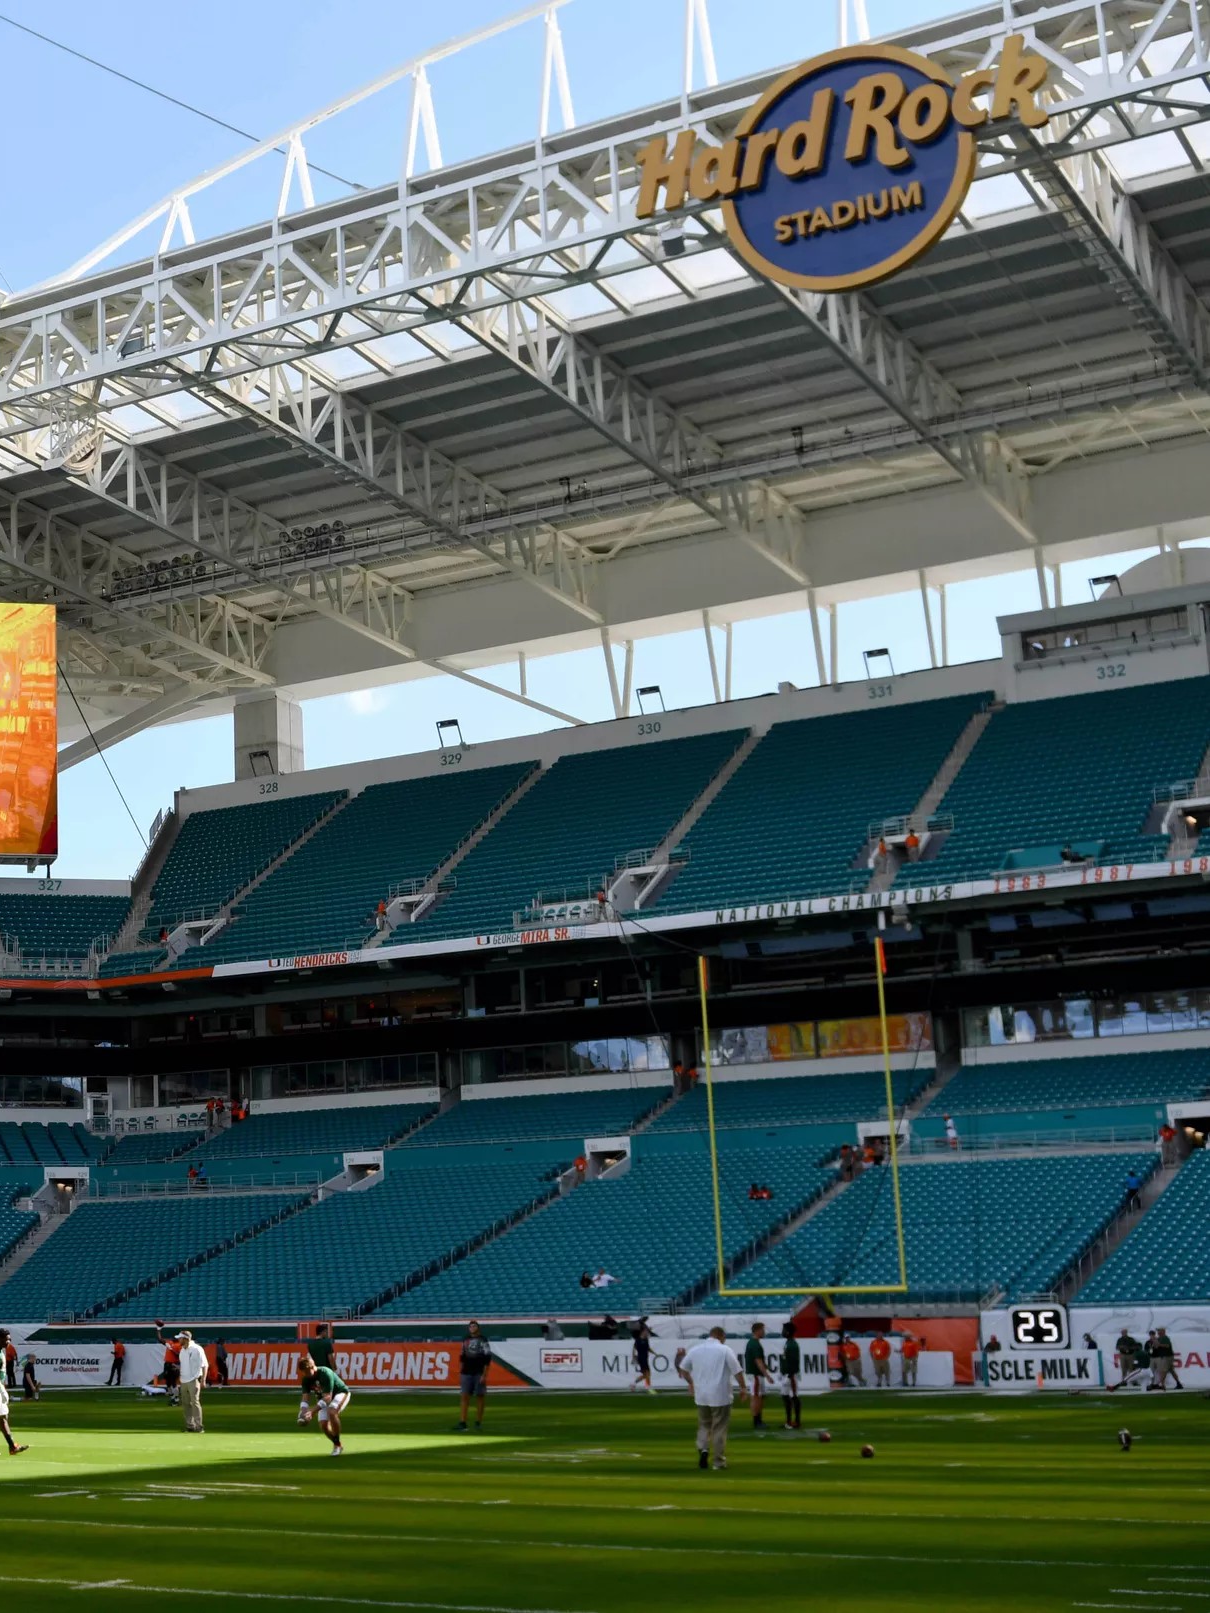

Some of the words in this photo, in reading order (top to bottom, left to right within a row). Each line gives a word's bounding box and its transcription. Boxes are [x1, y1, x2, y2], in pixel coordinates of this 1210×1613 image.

[636, 88, 835, 220] Hard
[844, 34, 1049, 168] Rock
[774, 181, 923, 243] STADIUM
[1096, 664, 1127, 680] 332
[868, 684, 893, 699] 331
[637, 722, 661, 735] 330
[440, 752, 462, 766] 329
[259, 782, 279, 794] 328
[994, 872, 1046, 894] 1983
[1080, 864, 1134, 884] 1987
[38, 880, 62, 891] 327
[716, 899, 815, 923] NATIONAL
[828, 886, 952, 912] CHAMPIONS
[492, 933, 520, 945] GEORGE
[554, 927, 570, 940] SR.
[282, 957, 294, 967] TED
[294, 952, 348, 968] HENDRICKS
[1017, 1311, 1059, 1342] 25
[227, 1352, 301, 1380] MIAMI
[306, 1352, 451, 1380] RRICANES
[544, 1353, 579, 1363] ESPN
[975, 1360, 1036, 1381] SCLE
[1041, 1358, 1089, 1379] MILK
